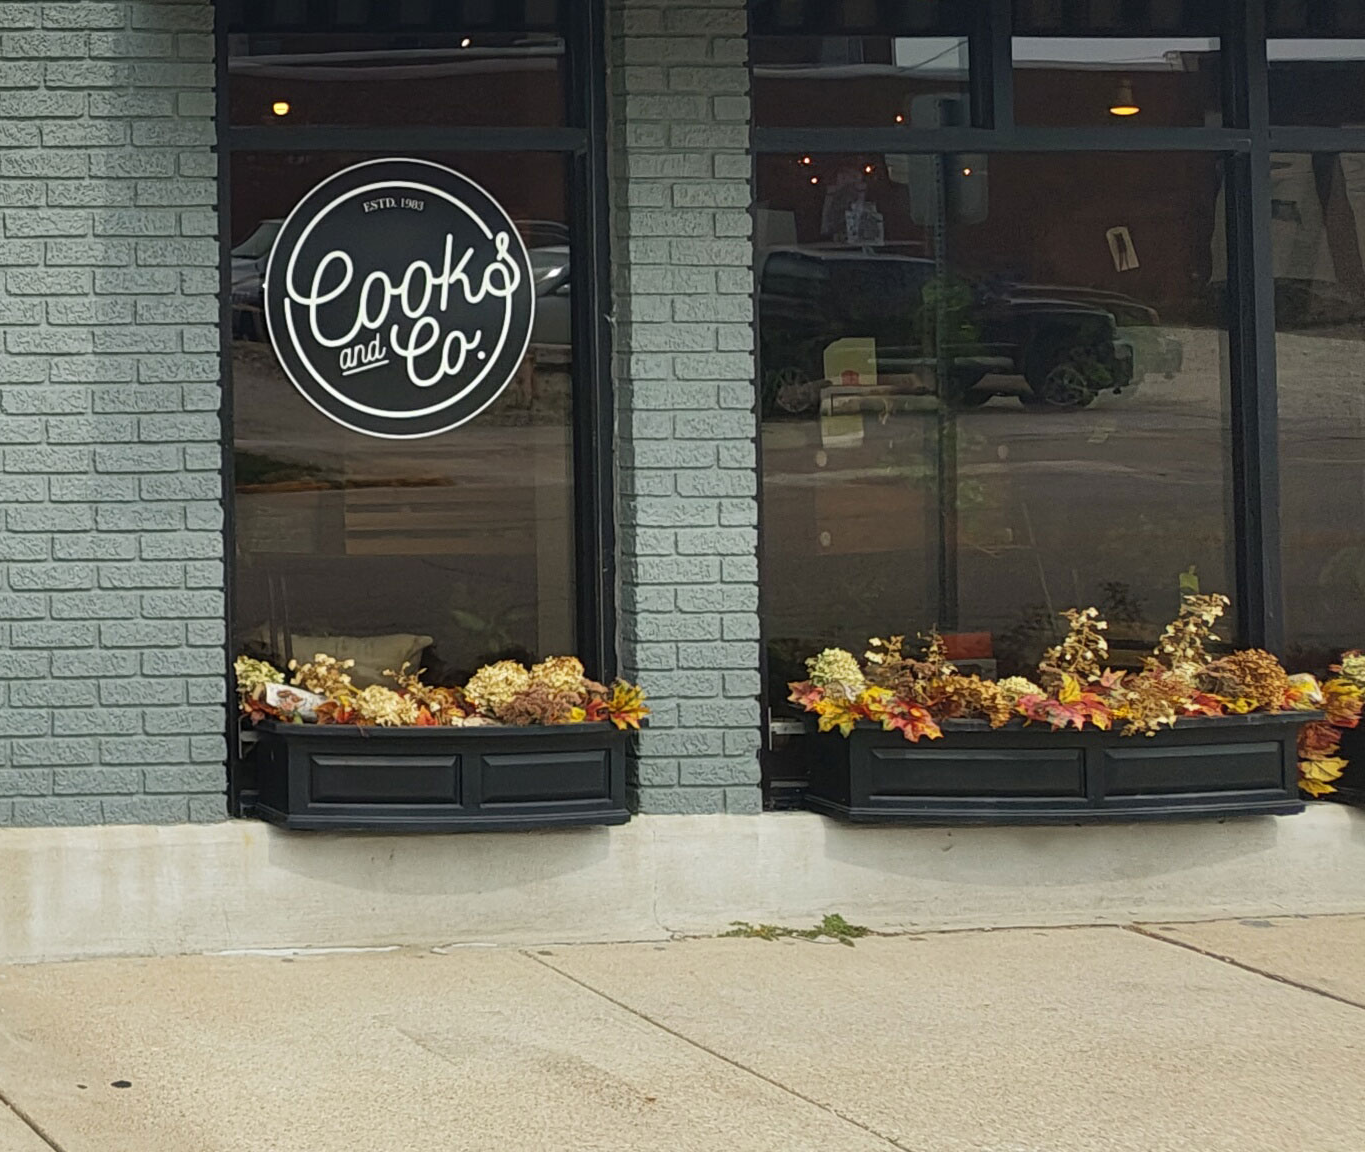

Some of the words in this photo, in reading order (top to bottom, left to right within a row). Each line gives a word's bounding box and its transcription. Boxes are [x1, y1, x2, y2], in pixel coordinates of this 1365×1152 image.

[362, 197, 398, 213] ESTD.
[400, 197, 425, 212] 1983
[287, 231, 521, 347] Cooks
[339, 333, 387, 370] and
[390, 316, 486, 387] Co.
